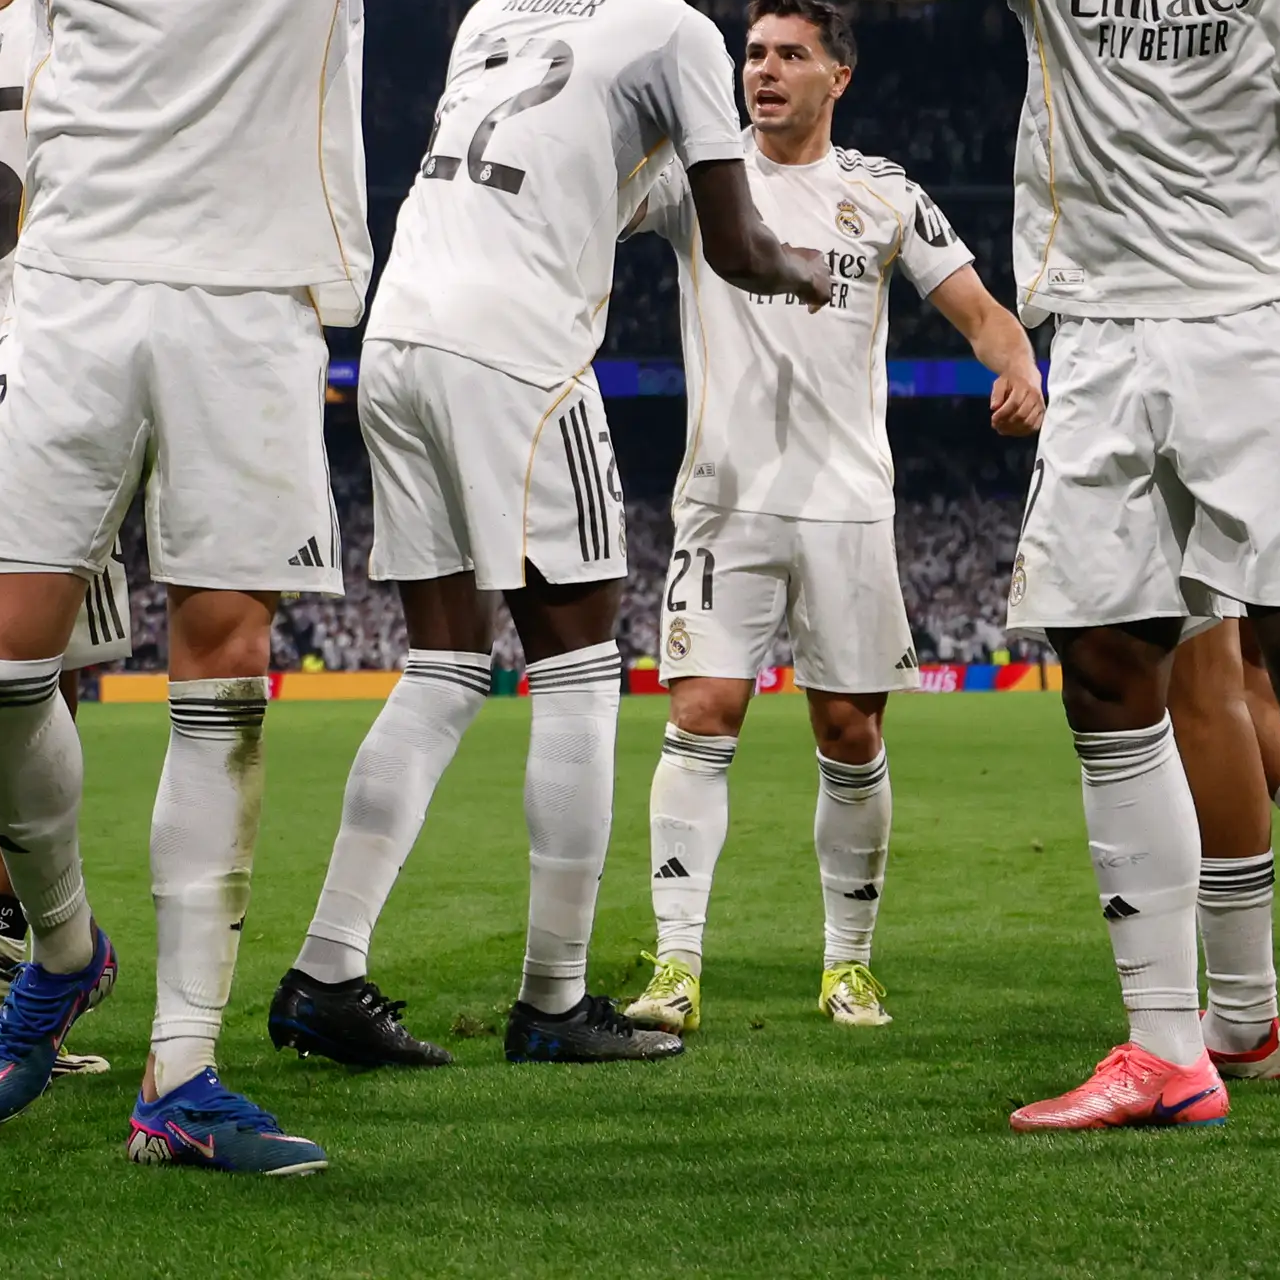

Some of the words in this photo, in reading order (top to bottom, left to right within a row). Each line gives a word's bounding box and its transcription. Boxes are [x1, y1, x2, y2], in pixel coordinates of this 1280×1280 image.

[1098, 24, 1134, 59] FLY
[1138, 20, 1229, 61] BETTER
[666, 548, 716, 611] 21
